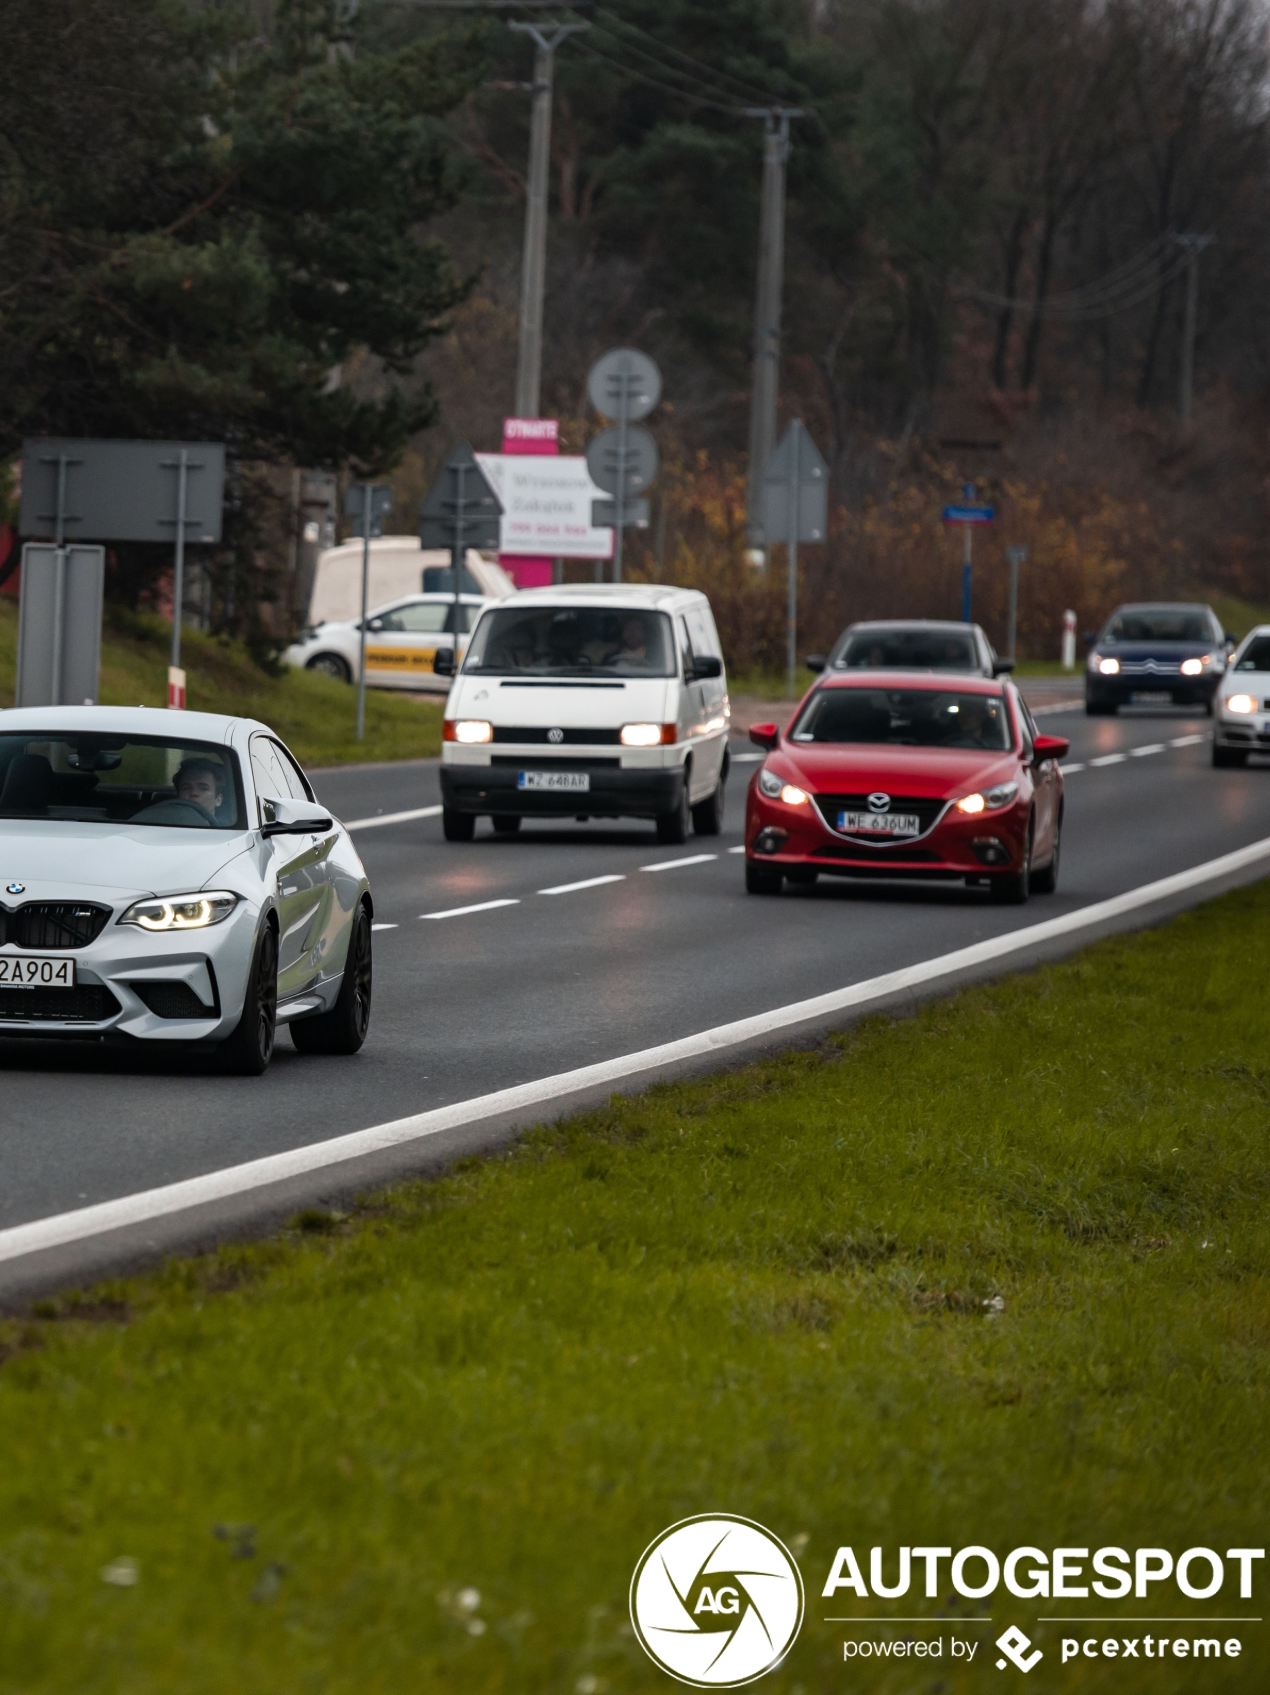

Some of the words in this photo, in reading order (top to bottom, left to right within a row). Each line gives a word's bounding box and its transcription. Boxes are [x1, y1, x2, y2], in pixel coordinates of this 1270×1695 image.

[505, 419, 558, 438] OTWARTE
[513, 474, 589, 490] Wrzosow
[847, 813, 867, 829] WE
[872, 814, 916, 832] 636UM
